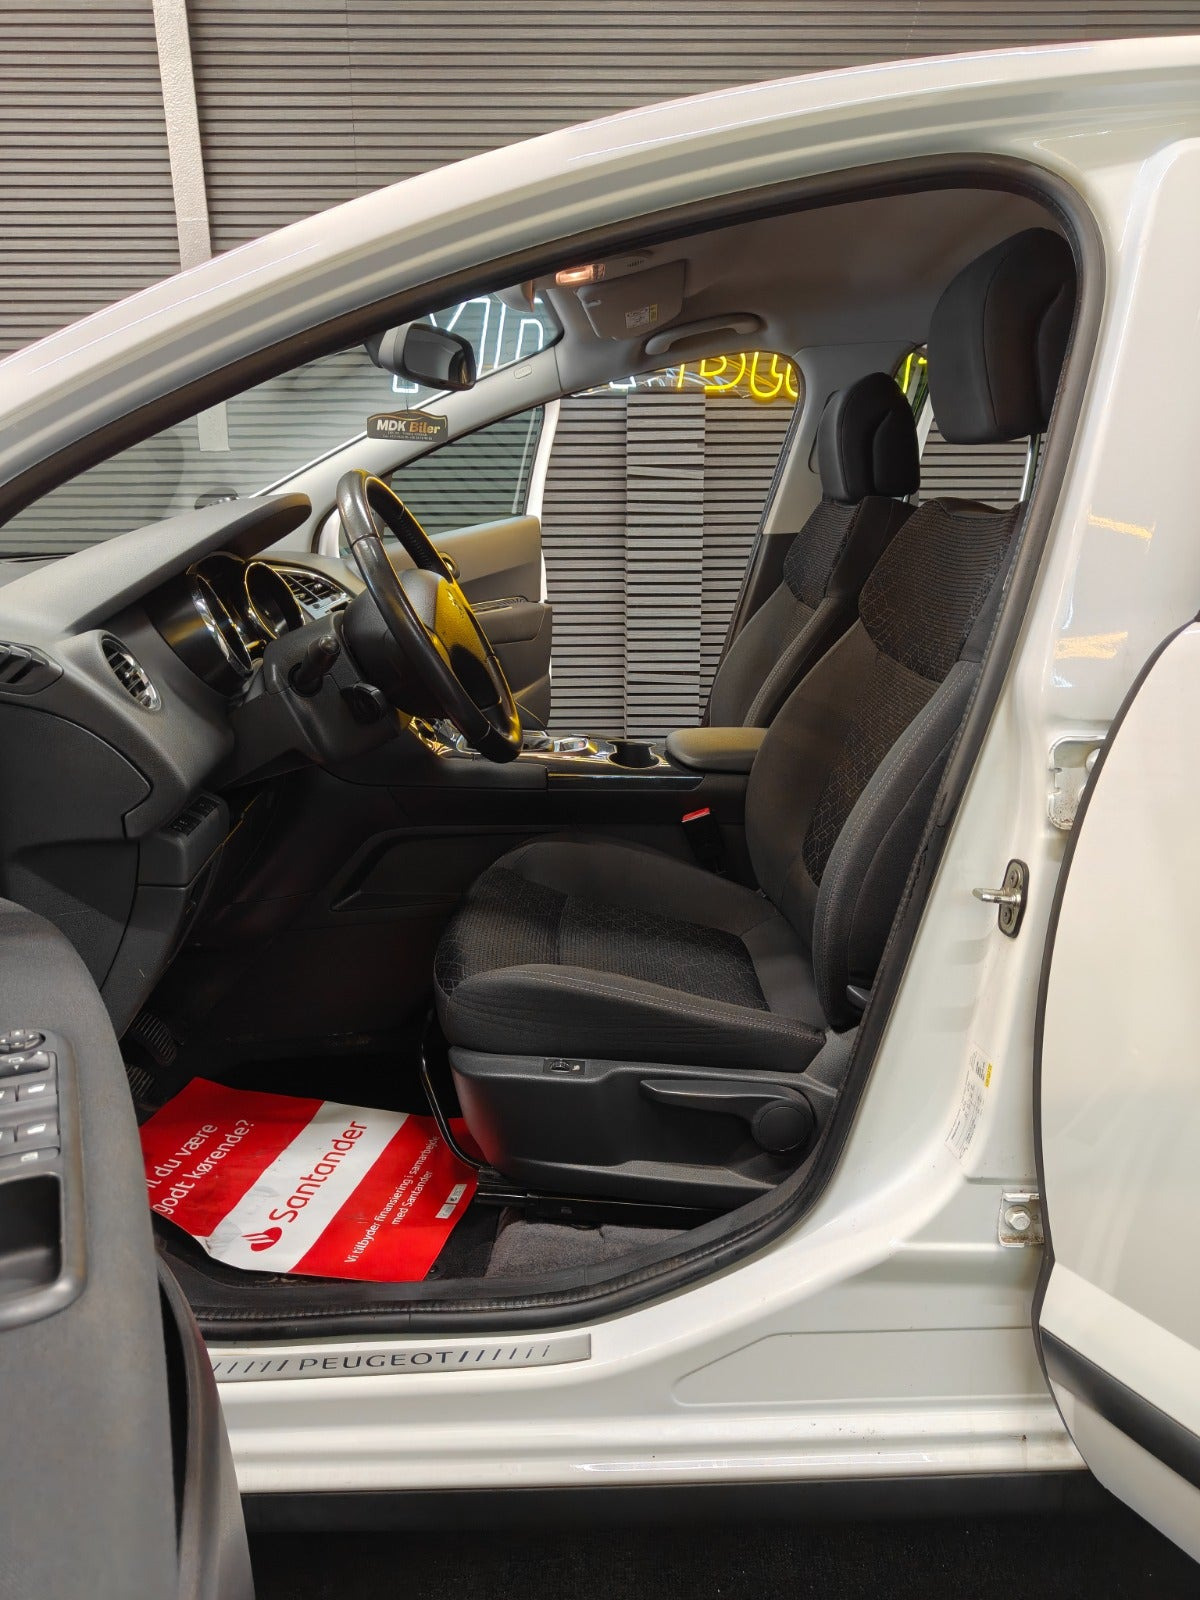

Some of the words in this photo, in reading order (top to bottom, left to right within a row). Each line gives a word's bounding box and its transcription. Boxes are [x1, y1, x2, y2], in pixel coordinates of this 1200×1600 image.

[376, 419, 407, 432] MDK
[409, 421, 441, 434] Biler
[152, 1181, 196, 1215] godt
[182, 1119, 255, 1179] kørende?
[154, 1158, 182, 1177] du
[175, 1124, 218, 1156] være
[268, 1120, 368, 1223] Santander
[344, 1254, 360, 1263] Vi
[352, 1220, 382, 1255] tilbyder
[374, 1178, 414, 1223] finansiering
[409, 1136, 440, 1176] samarbejde
[391, 1206, 409, 1225] med
[402, 1170, 433, 1207] Santander
[298, 1350, 454, 1371] PEUGEOT
